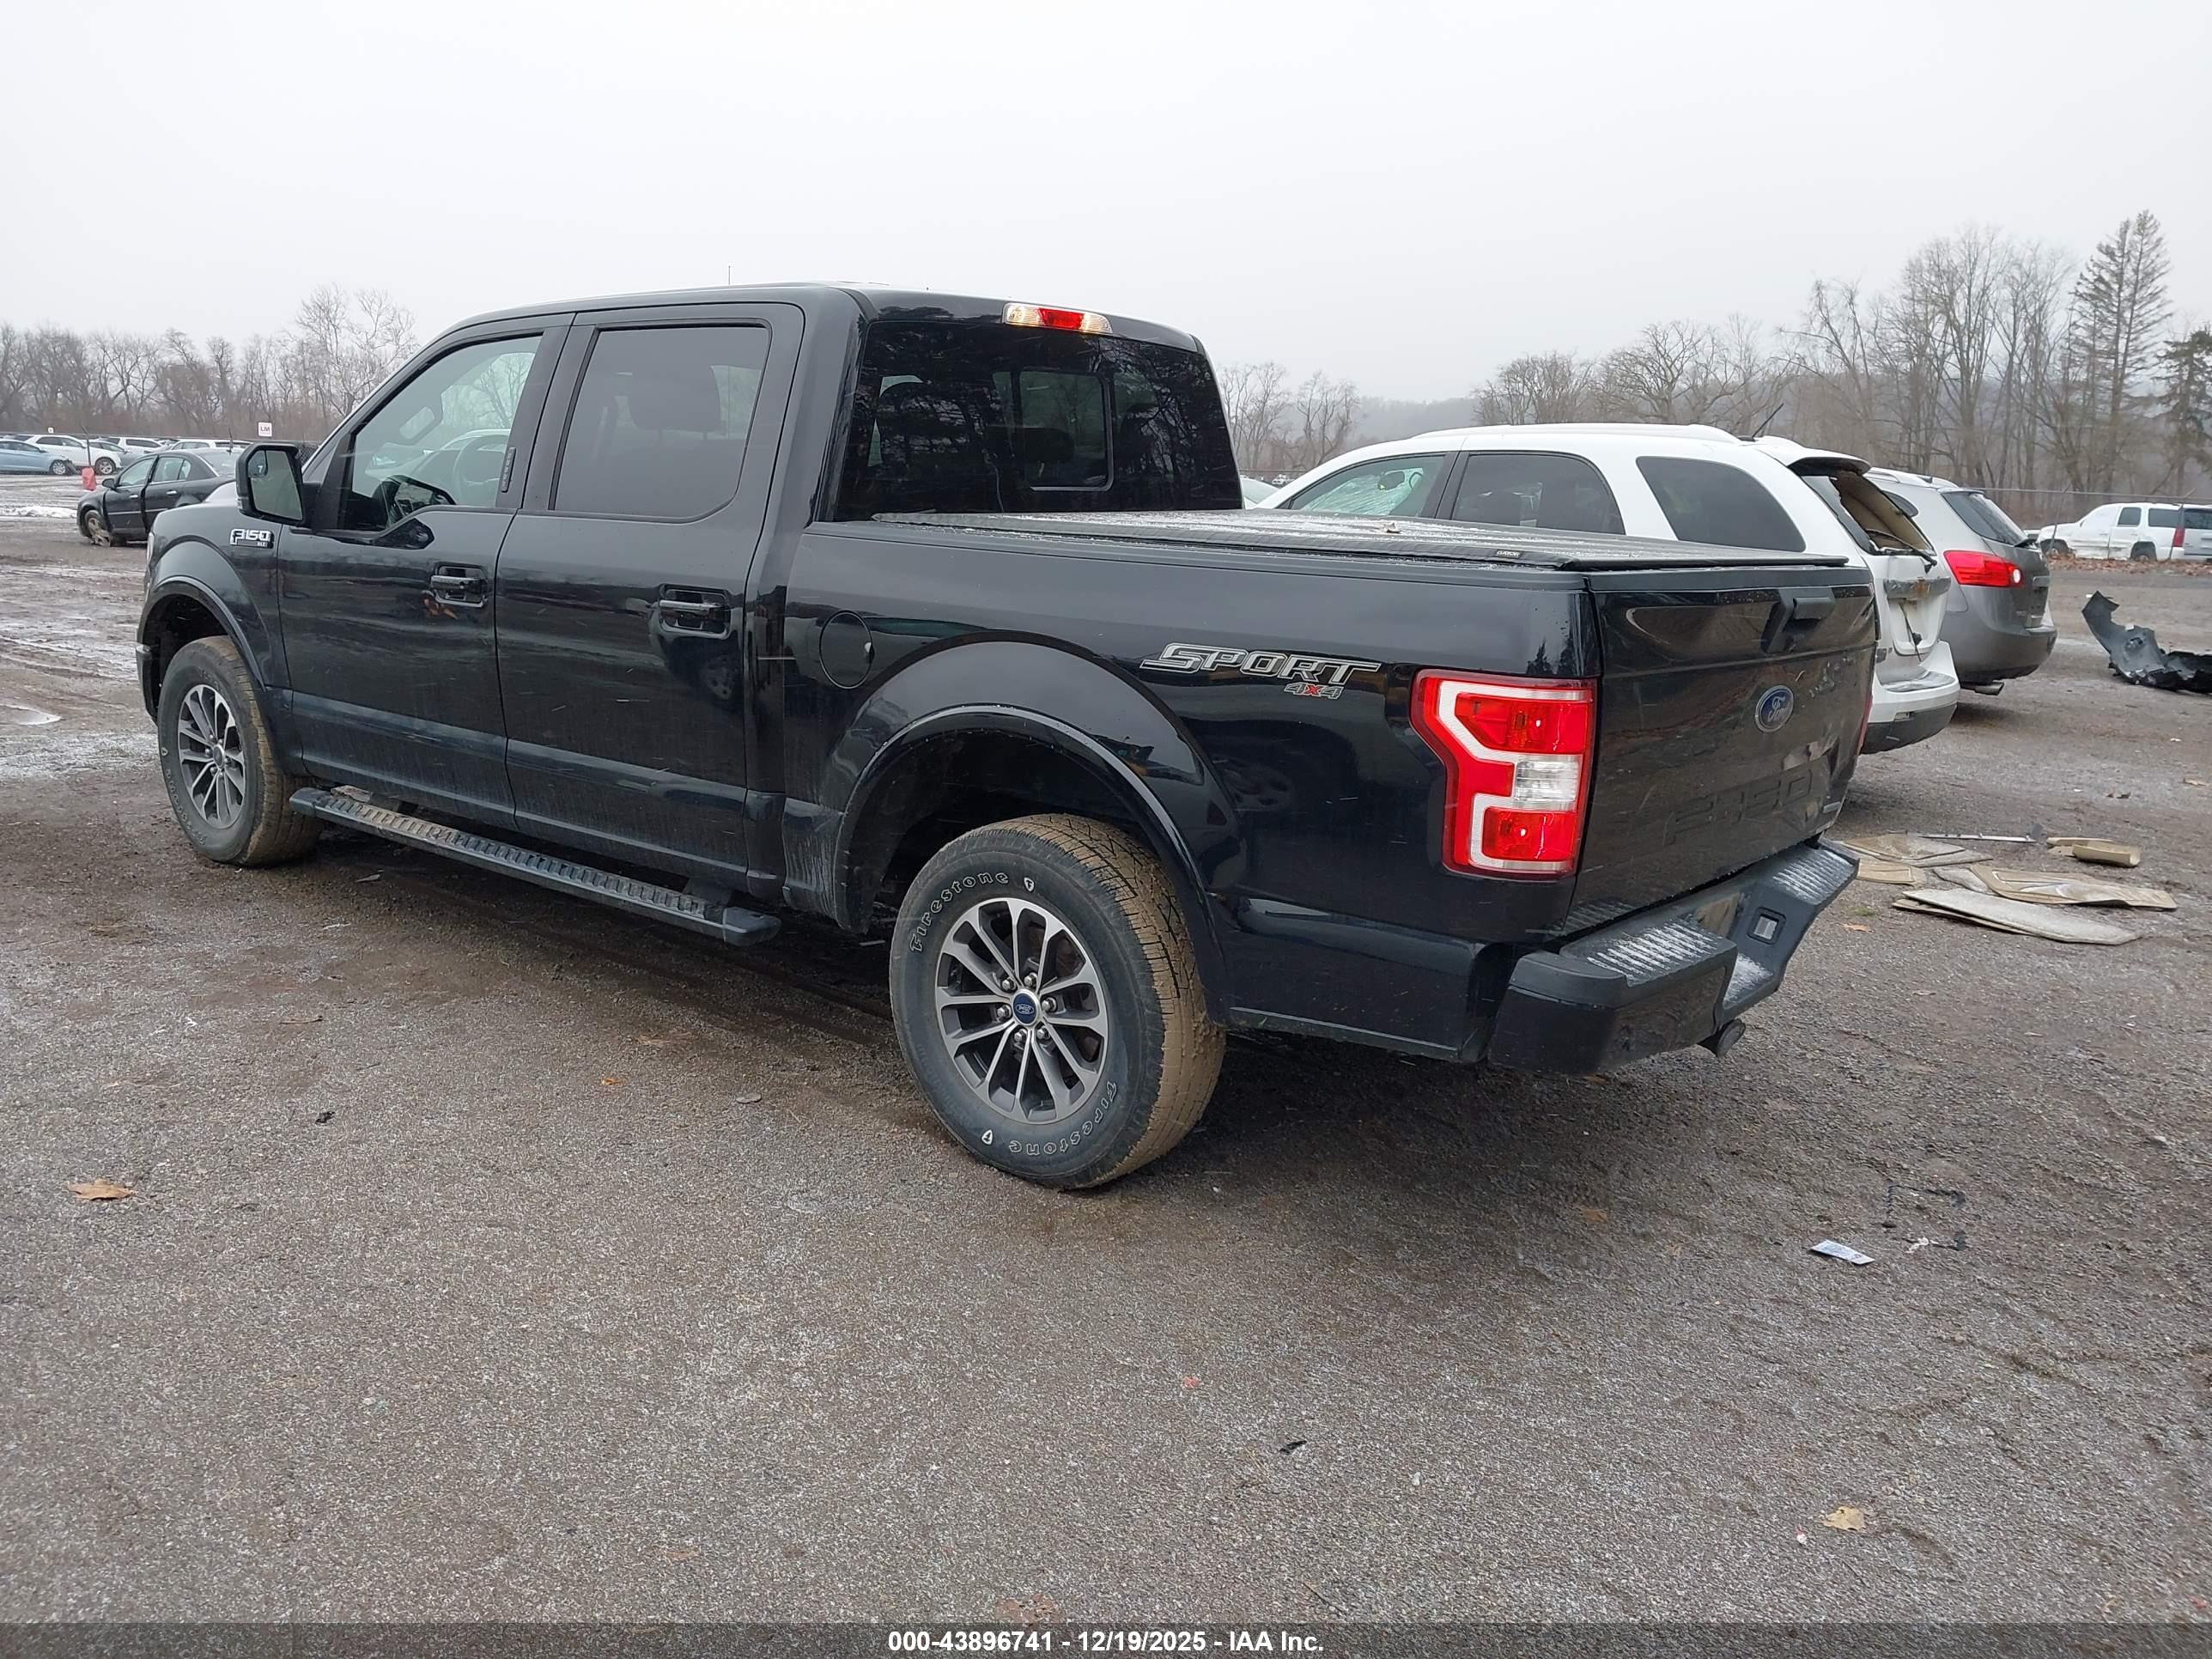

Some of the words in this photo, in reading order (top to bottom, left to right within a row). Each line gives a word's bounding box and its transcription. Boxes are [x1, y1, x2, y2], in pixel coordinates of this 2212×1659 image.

[1139, 642, 1382, 685] SPORT
[910, 872, 1009, 952] Firestone
[1009, 1081, 1117, 1156] Firestone
